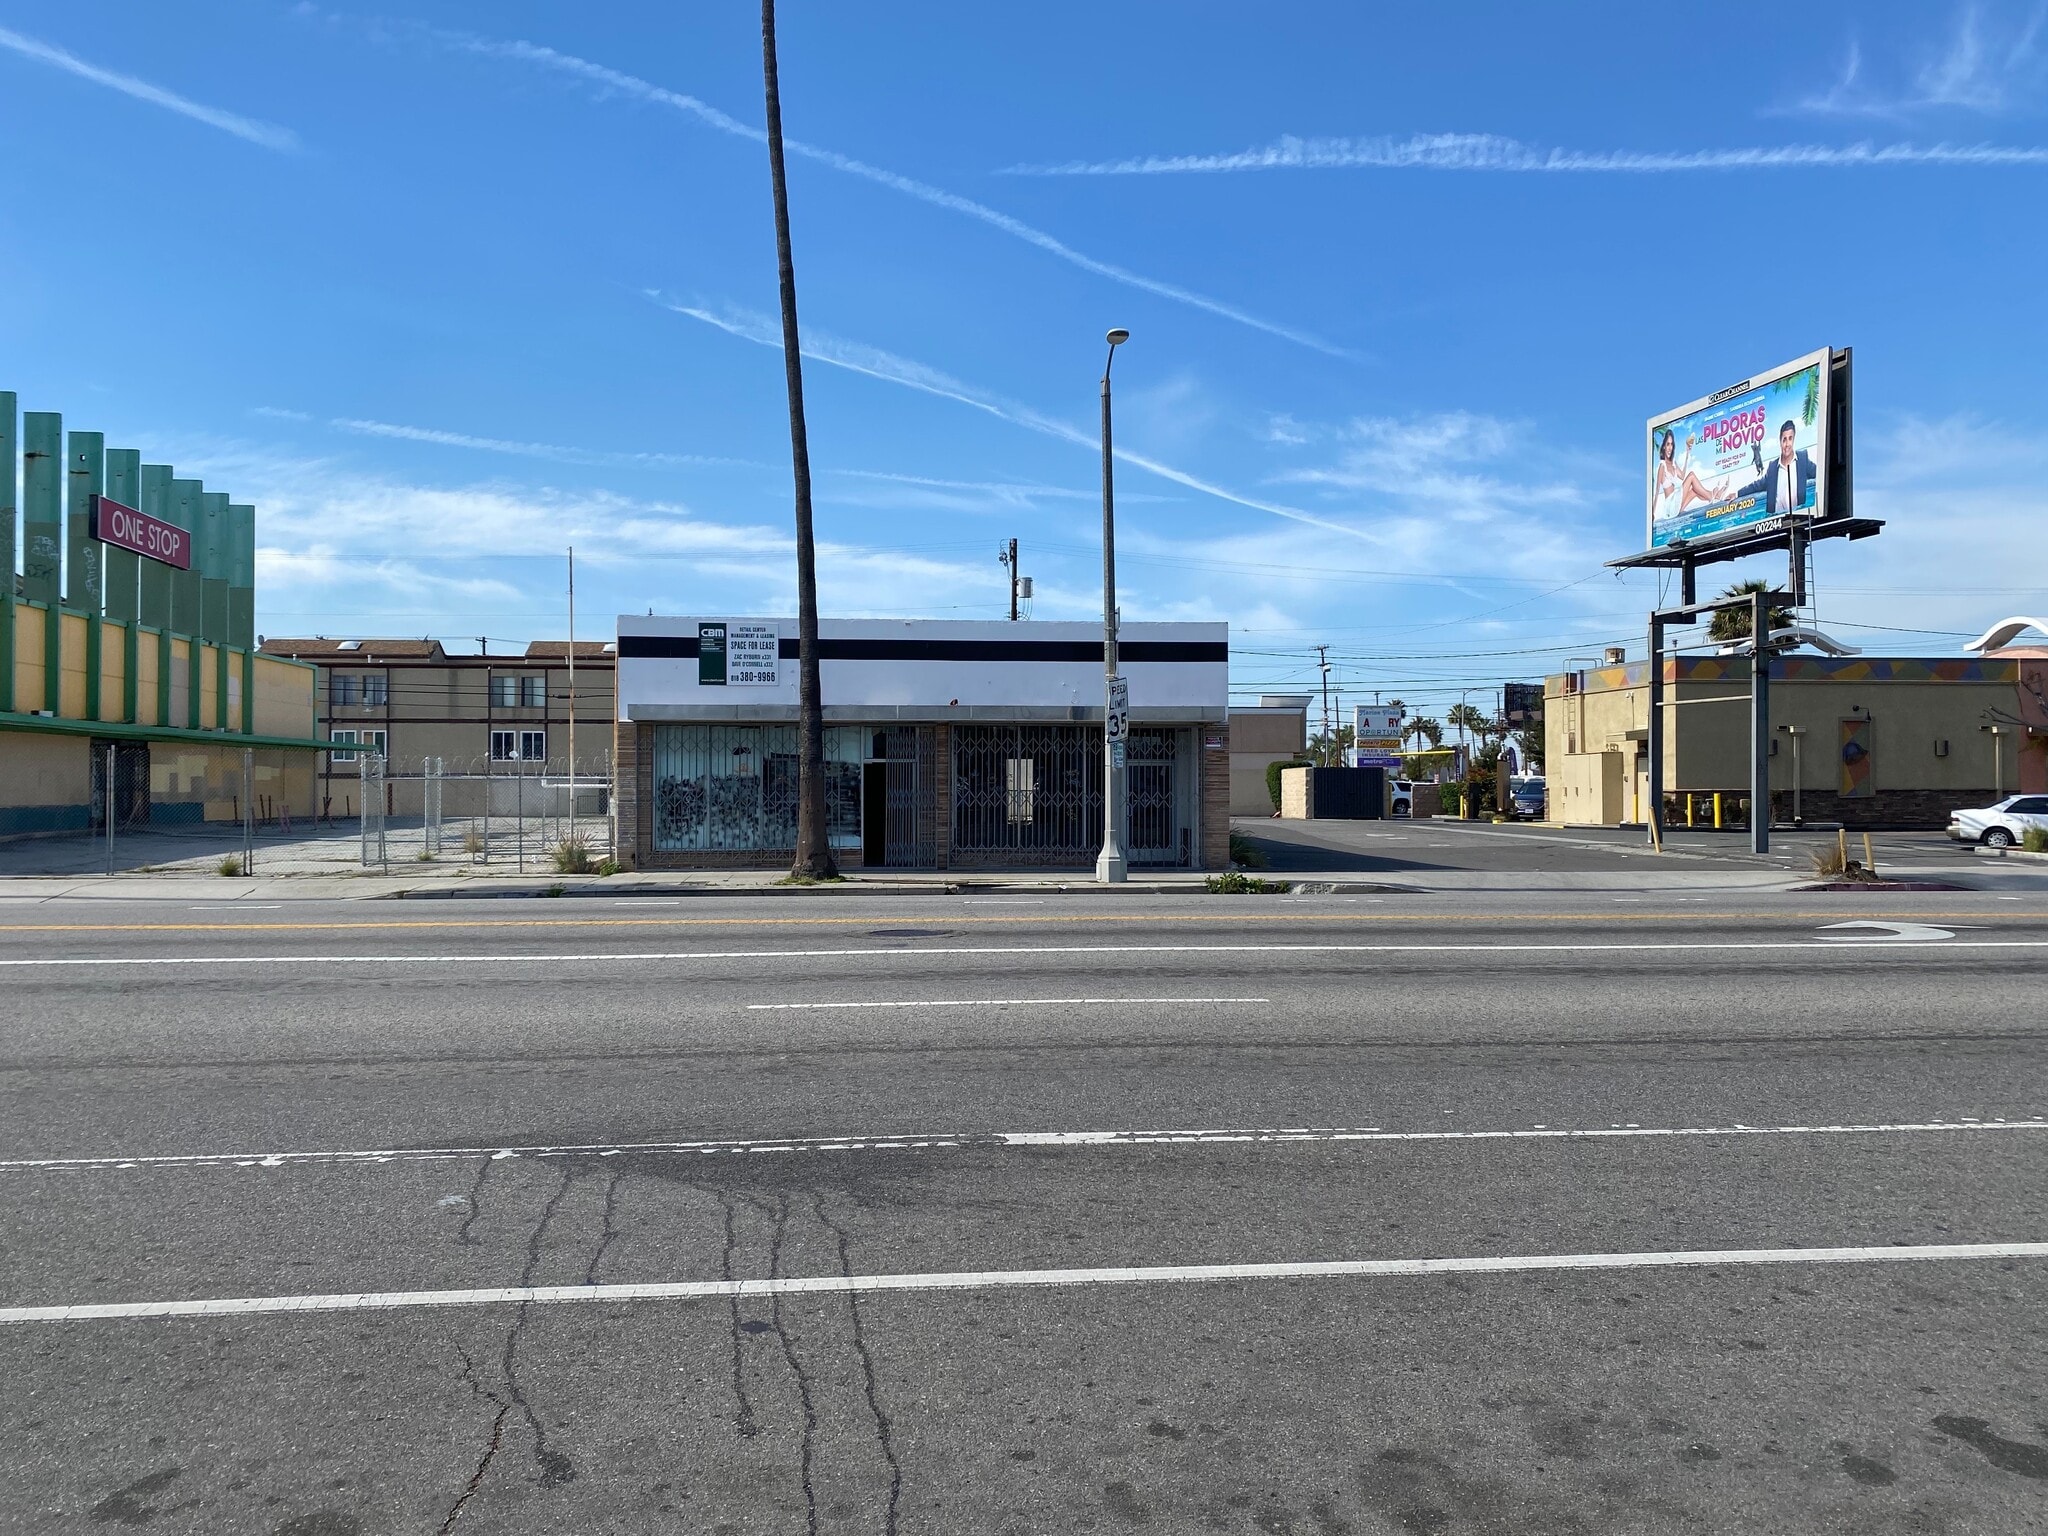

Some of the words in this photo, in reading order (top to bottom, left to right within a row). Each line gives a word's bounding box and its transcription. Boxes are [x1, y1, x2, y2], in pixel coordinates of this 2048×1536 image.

[1695, 435, 1703, 446] LAS
[1704, 405, 1765, 442] PILDORAS
[1716, 437, 1722, 446] DE
[1723, 424, 1765, 453] NOVIO
[1705, 503, 1738, 519] FEBRUARY
[1739, 498, 1756, 510] 2020
[112, 510, 143, 545] ONE
[148, 524, 180, 557] STOP
[1755, 519, 1782, 535] 002244
[731, 641, 746, 650] SPACE
[748, 641, 758, 650] FOR
[760, 641, 775, 650] LEASE
[740, 672, 775, 682] 380-9966
[1110, 698, 1125, 710] LIMIT
[1109, 711, 1127, 737] 35
[1363, 718, 1370, 727] A
[1388, 718, 1400, 727] RY
